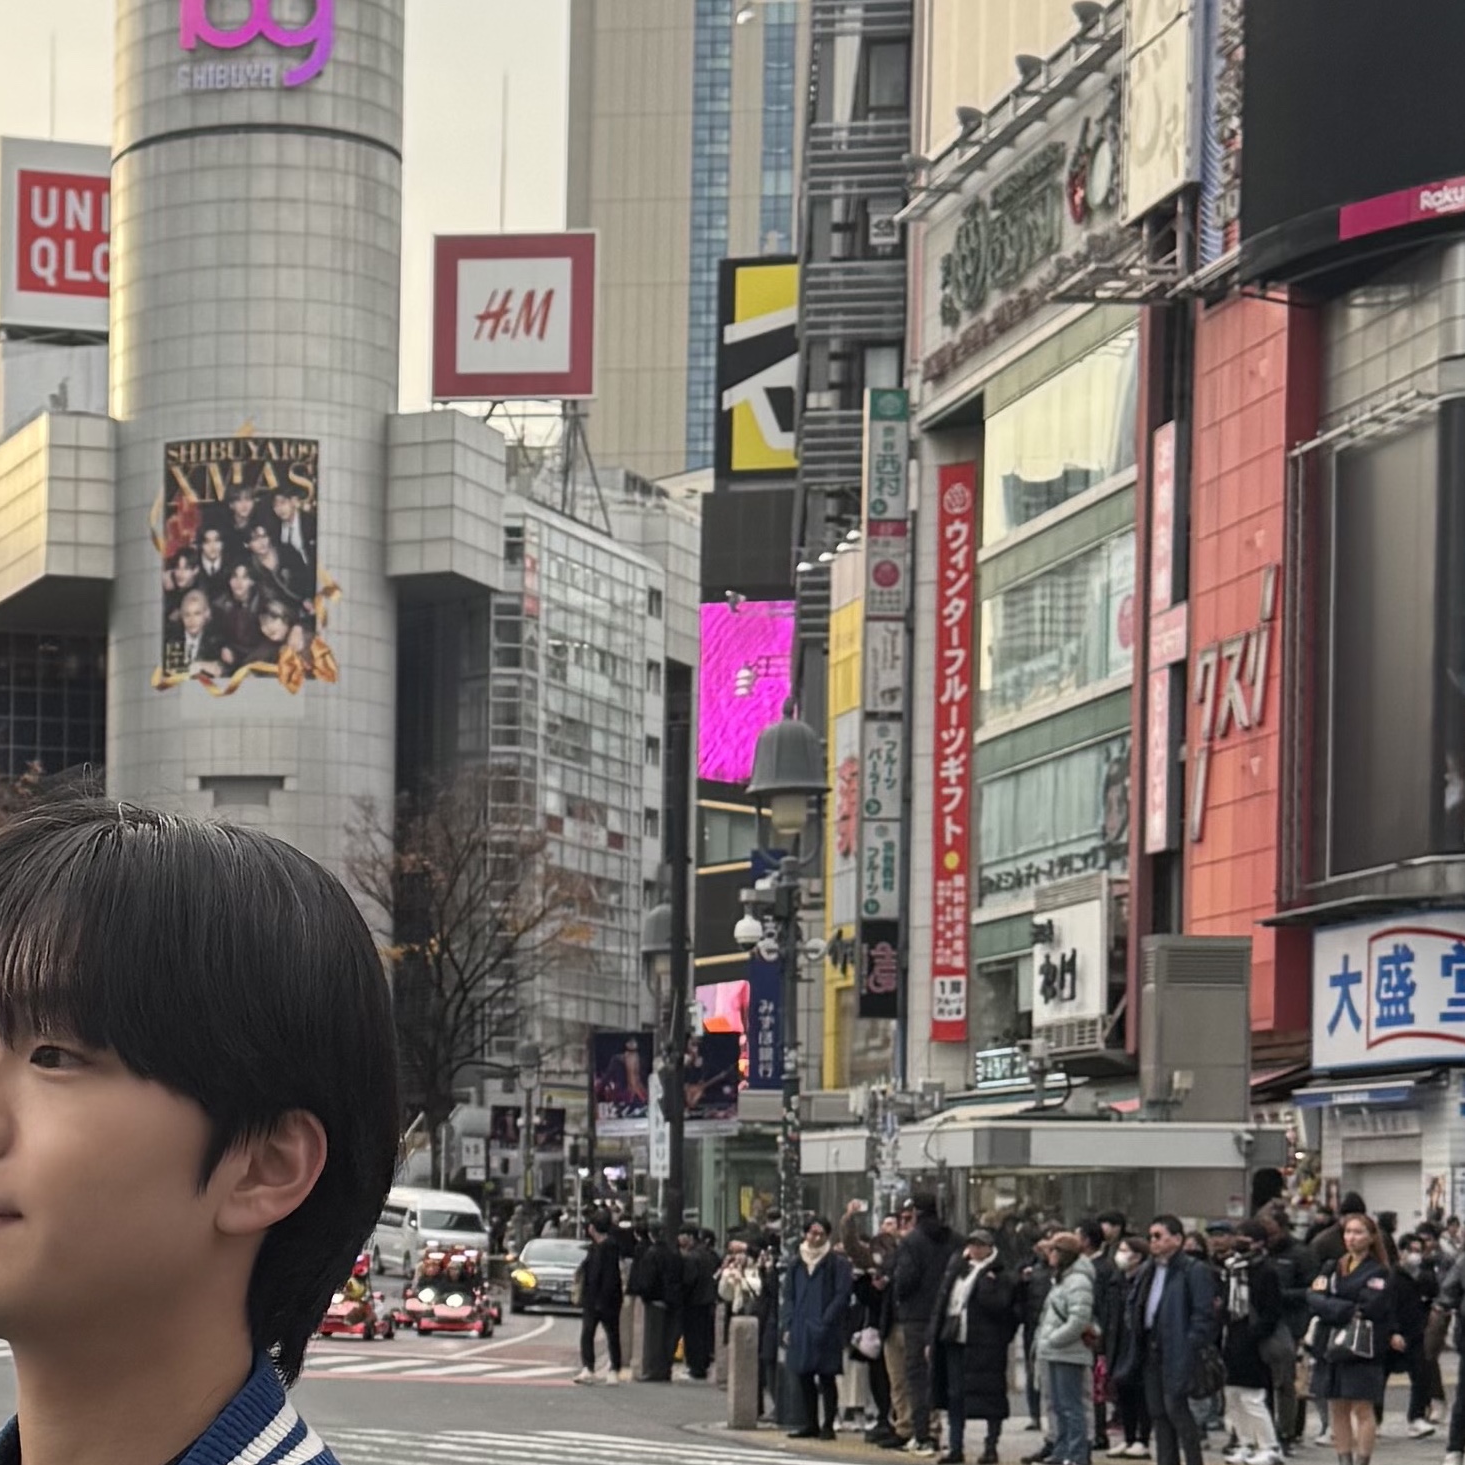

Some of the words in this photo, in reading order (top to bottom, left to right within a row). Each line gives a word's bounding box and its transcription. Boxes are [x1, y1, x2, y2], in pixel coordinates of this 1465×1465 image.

[178, 63, 276, 89] SHIBUYA
[31, 185, 111, 235] UNI
[30, 236, 111, 287] QLO
[474, 288, 554, 341] H&M
[167, 438, 318, 466] SHIBUYA109
[167, 460, 318, 503] XMAS
[940, 519, 969, 846] ウィンターフルーツギフト
[757, 999, 775, 1079] みずほ銀行
